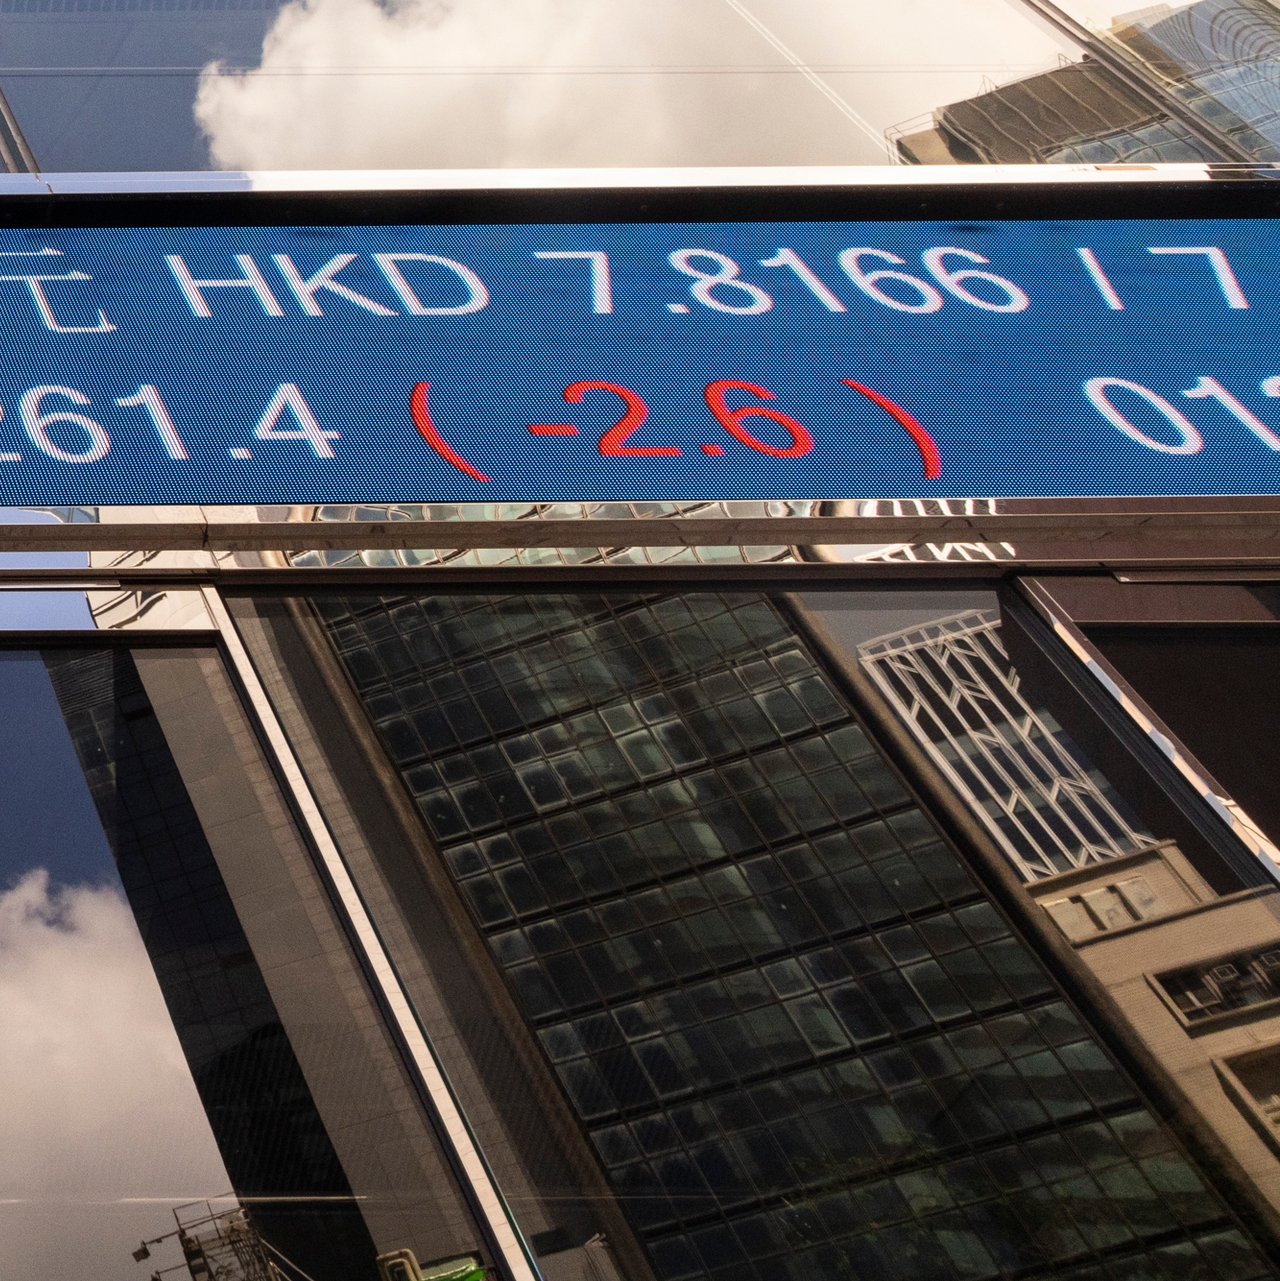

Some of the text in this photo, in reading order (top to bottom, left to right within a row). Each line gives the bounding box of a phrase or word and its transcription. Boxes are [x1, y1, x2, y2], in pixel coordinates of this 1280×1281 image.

[165, 251, 492, 319] HKD
[533, 247, 1032, 317] 7.8166
[1146, 246, 1251, 311] 7
[1082, 374, 1280, 456] 01
